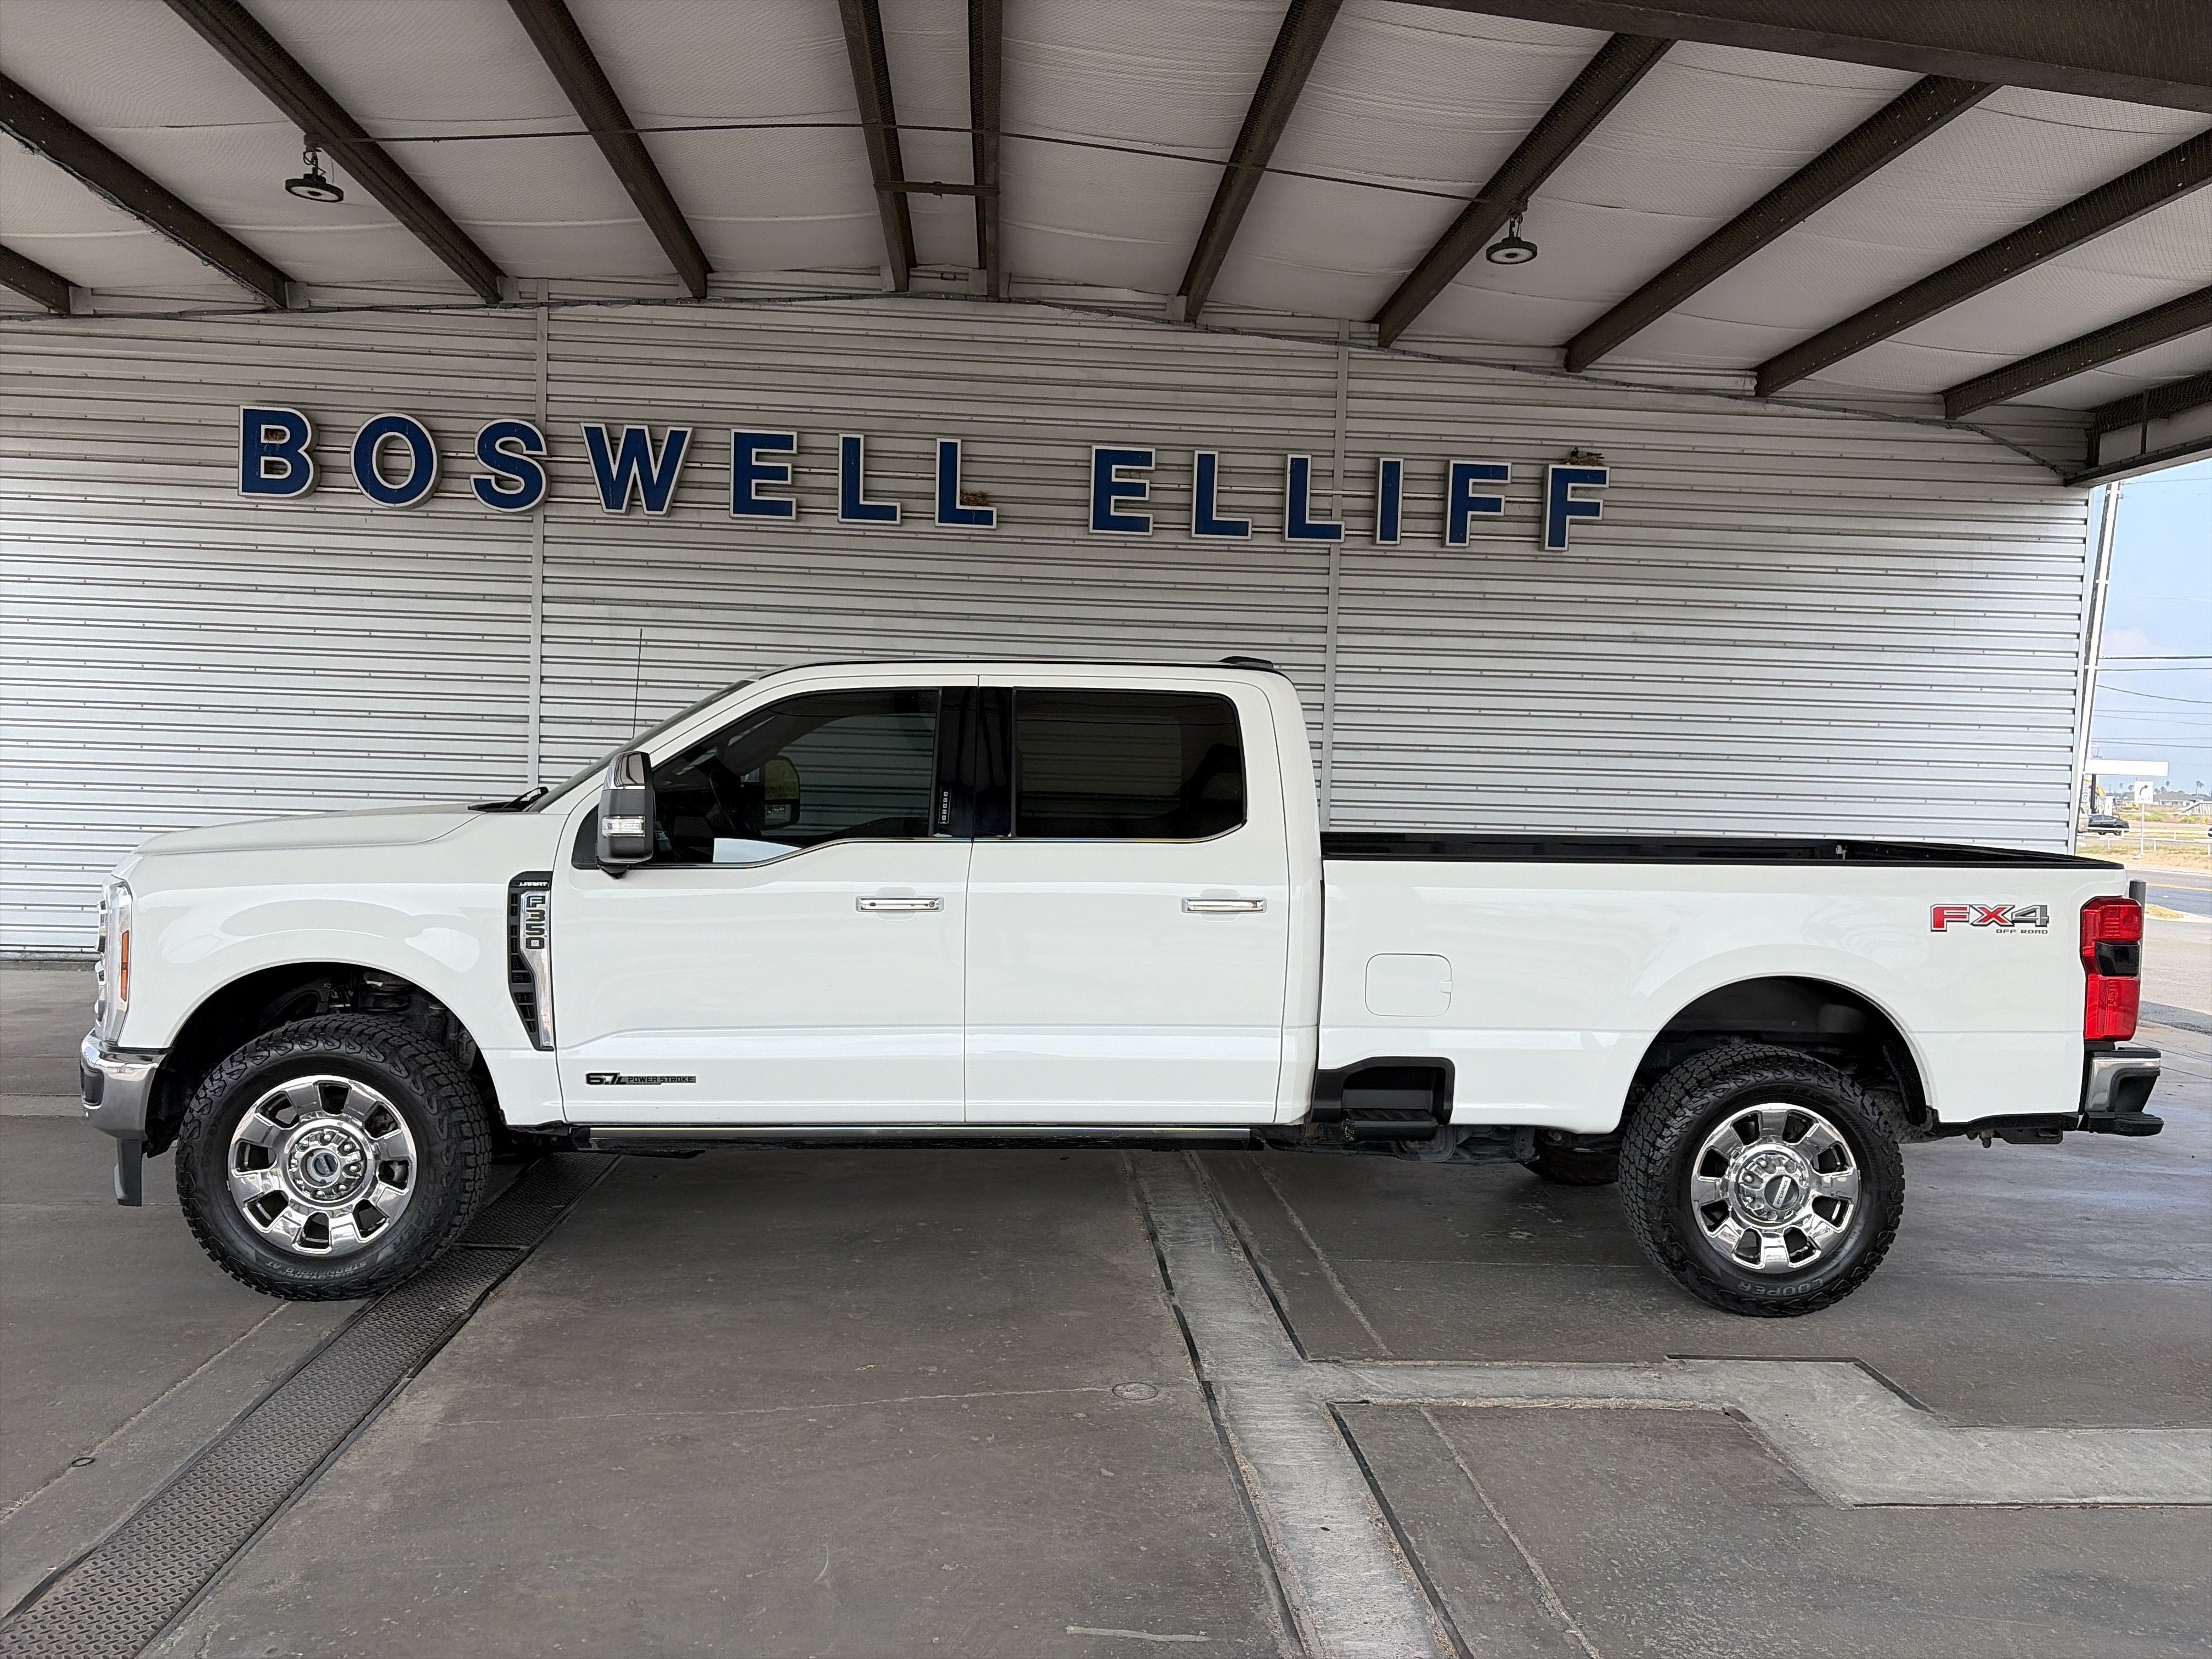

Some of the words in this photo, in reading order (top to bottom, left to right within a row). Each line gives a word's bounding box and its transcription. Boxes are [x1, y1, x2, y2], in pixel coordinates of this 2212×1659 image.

[238, 405, 997, 529] BOSWELL
[1090, 445, 1609, 551] ELLIFF
[1931, 904, 2049, 932] FX4
[586, 1073, 627, 1085] 6.7L
[1776, 1180, 1788, 1204] FORD
[1737, 1278, 1824, 1297] COOPER
